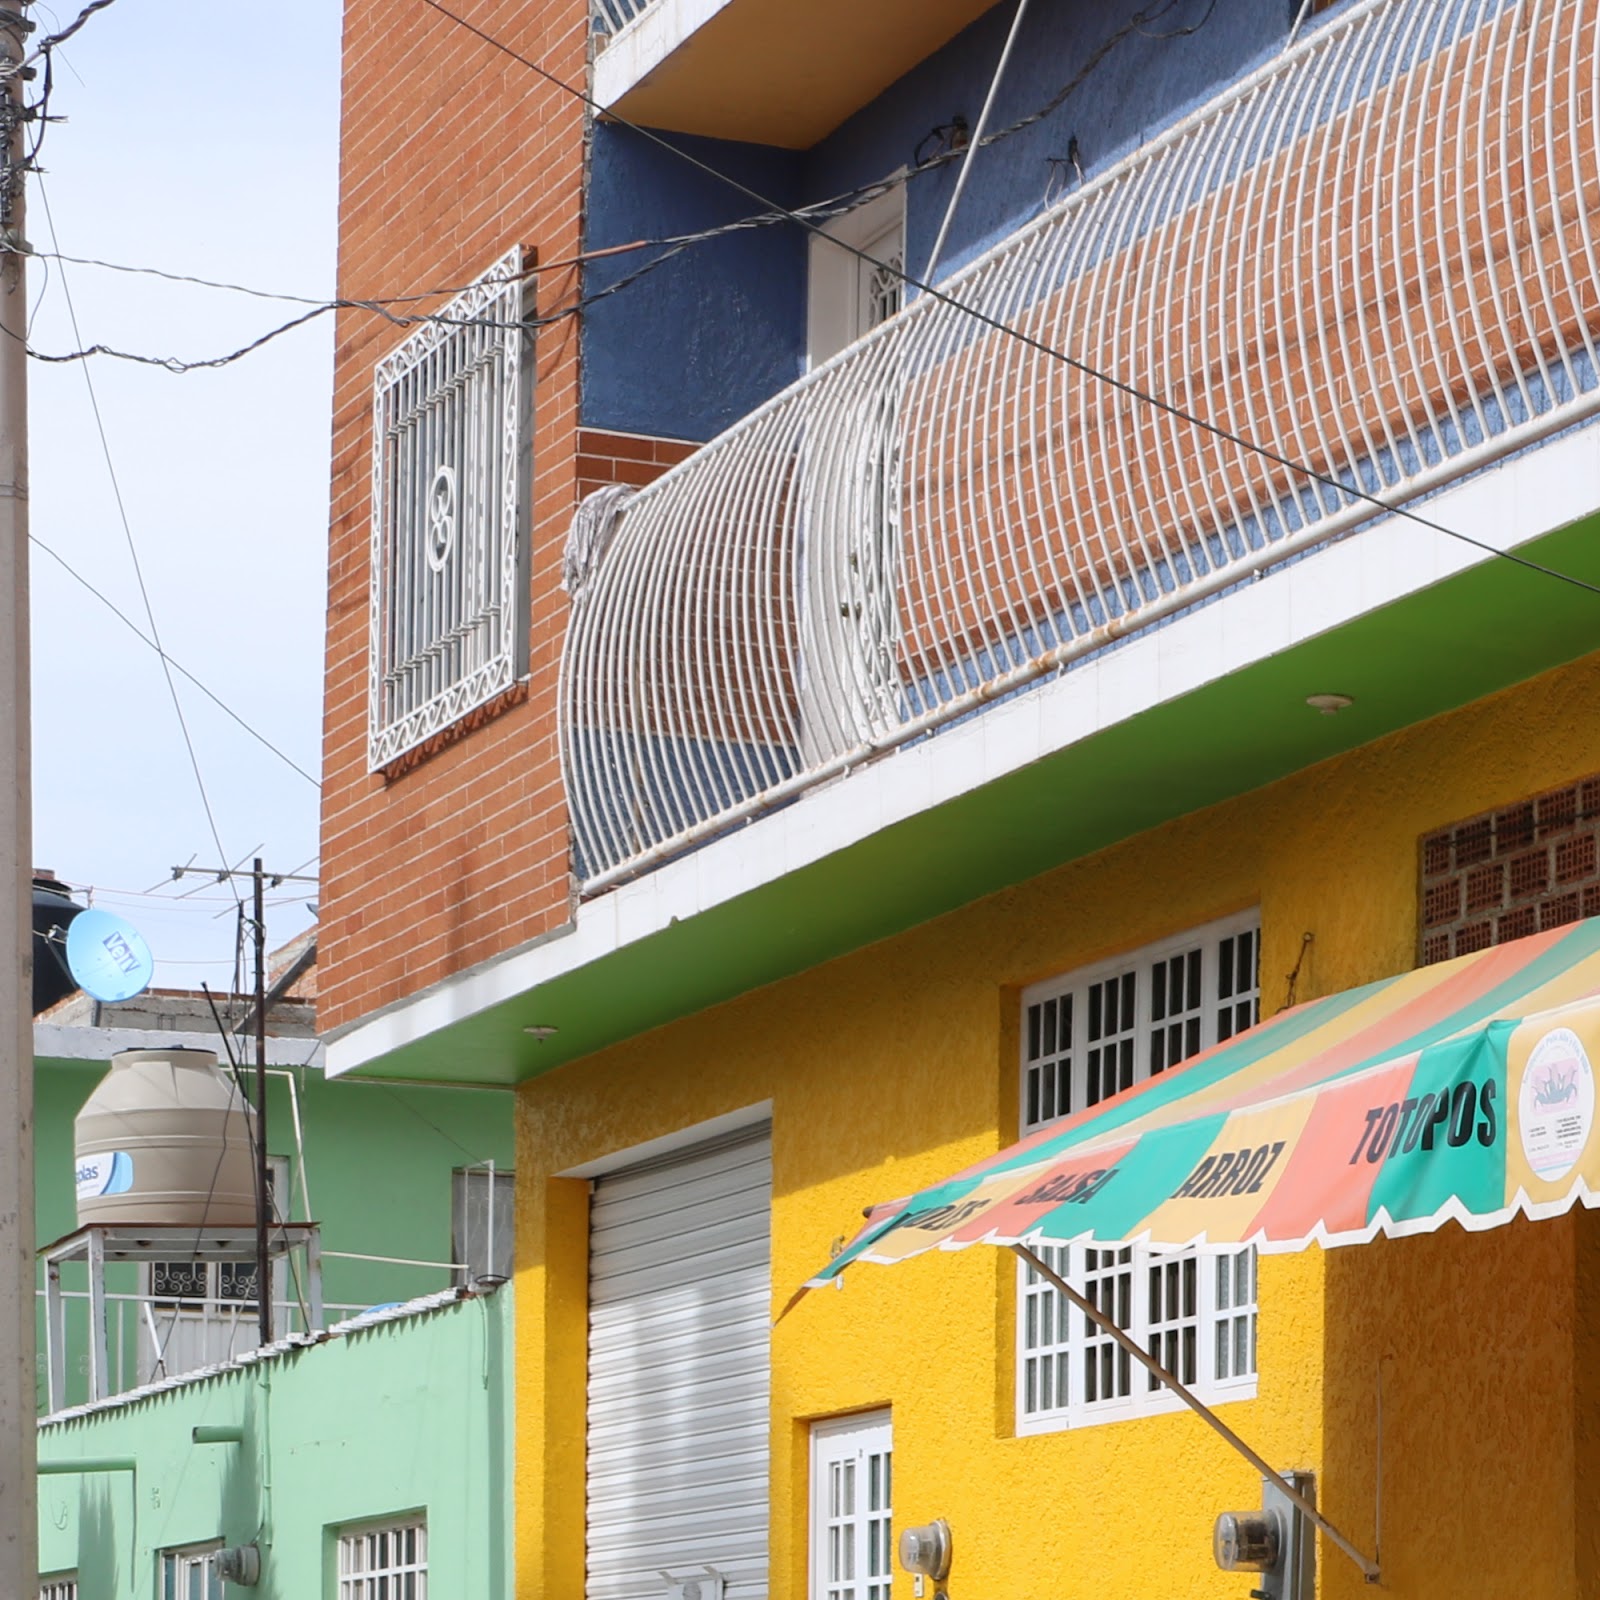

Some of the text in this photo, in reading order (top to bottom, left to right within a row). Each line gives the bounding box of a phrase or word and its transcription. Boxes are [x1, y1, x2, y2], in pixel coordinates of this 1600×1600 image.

[103, 931, 142, 976] VeTV
[1014, 1168, 1121, 1205] SALSA
[1170, 1140, 1284, 1200] ARROZ
[1348, 1077, 1497, 1165] TOTOPOS
[75, 1163, 99, 1184] plas
